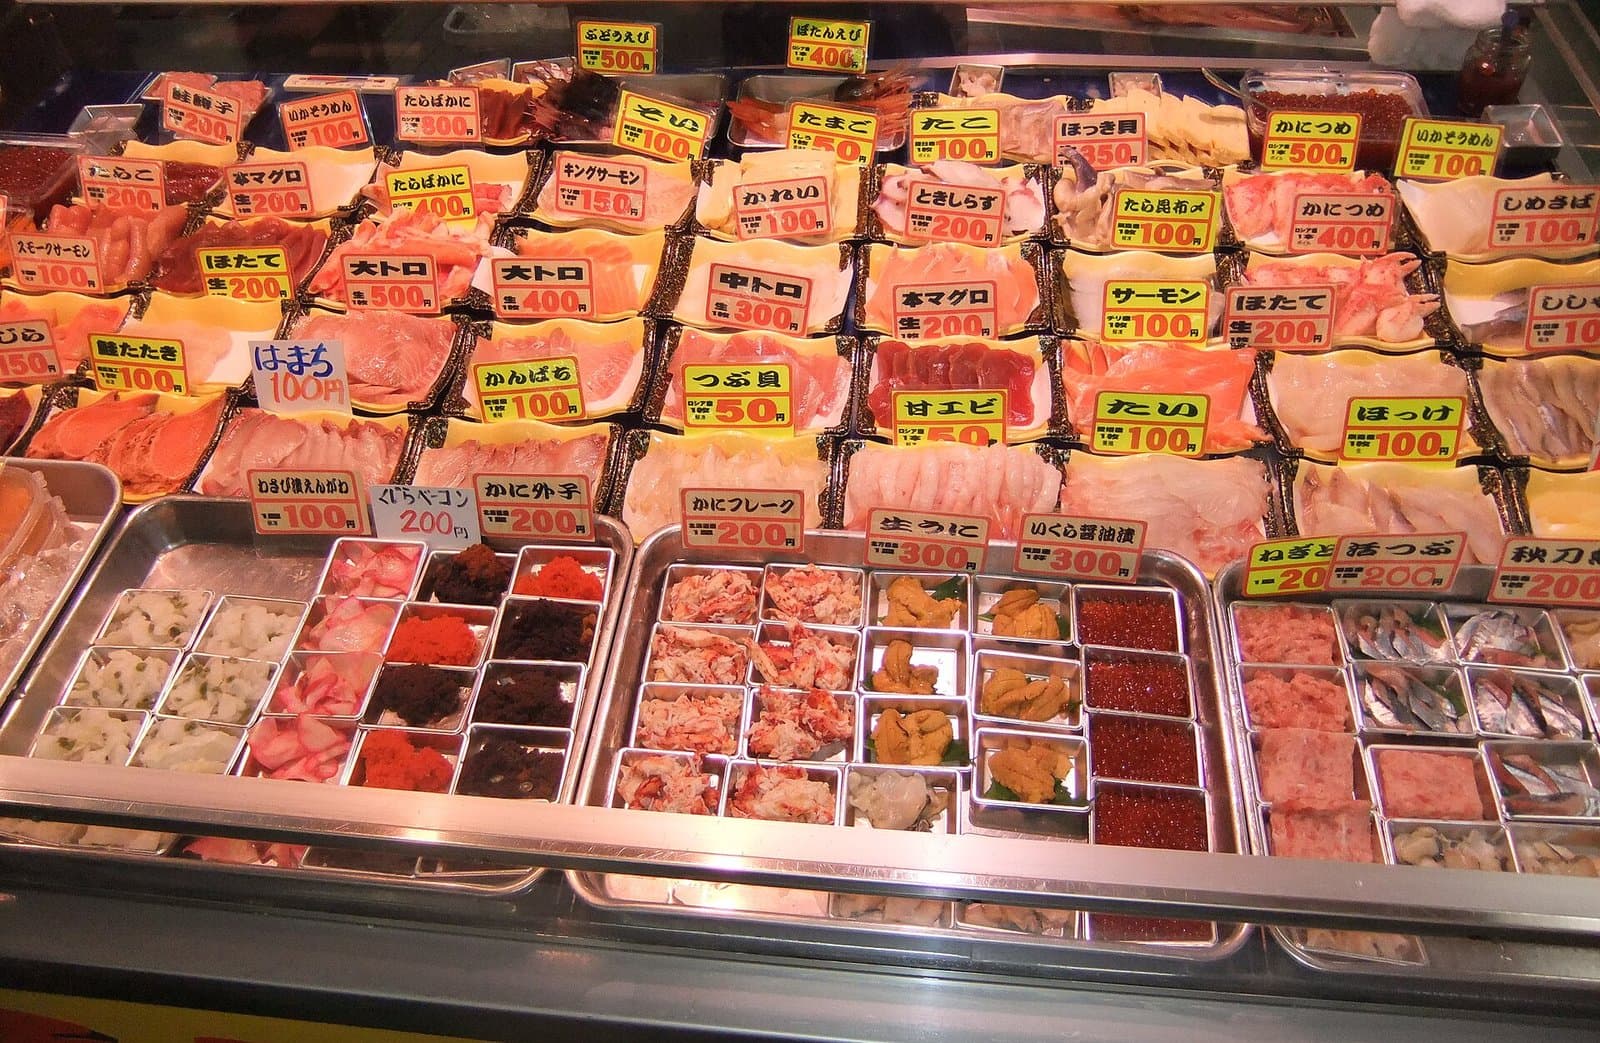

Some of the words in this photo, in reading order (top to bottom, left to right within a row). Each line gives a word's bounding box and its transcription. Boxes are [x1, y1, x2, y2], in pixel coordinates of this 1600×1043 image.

[585, 29, 650, 43] ぶどうえび
[797, 24, 862, 41] ぼたんえび
[601, 50, 649, 70] 500円
[810, 47, 858, 68] 400円
[288, 100, 352, 122] いかそうめん
[404, 94, 471, 108] たらばかに
[184, 113, 232, 143] 200円
[421, 115, 473, 135] 800円
[633, 104, 699, 132] そい
[799, 111, 872, 133] たまご
[921, 117, 991, 131] たこ
[1061, 120, 1137, 136] ほっき貝
[1276, 119, 1351, 135] かにつめ
[311, 121, 360, 145] 100円
[1416, 128, 1493, 147] いかそうめん
[643, 130, 694, 160] 100円
[813, 135, 866, 163] 50円
[936, 138, 993, 159] 100円
[1080, 144, 1137, 165] 350円
[1289, 143, 1347, 165] 500円
[233, 168, 301, 187] 本マグロ
[393, 174, 465, 192] たらばかに
[564, 163, 639, 185] キングサーモン
[107, 187, 159, 210] 200円
[234, 193, 251, 206] 生
[254, 192, 308, 213] 200円
[415, 196, 470, 217] 400円
[580, 189, 638, 216] 150円
[743, 186, 819, 206] かれい
[916, 189, 998, 210] ときしらず
[1504, 193, 1595, 211] しめさば
[1303, 202, 1384, 217] かにつめ
[766, 209, 823, 232] 100円
[932, 215, 992, 242] 200円
[1525, 220, 1586, 242] 100円
[1140, 223, 1200, 245] 100円
[1317, 227, 1380, 249] 400円
[18, 240, 90, 258] スモークサーモン
[206, 254, 280, 269] ほたて
[350, 260, 426, 276] 大トロ
[38, 265, 96, 288] 100円
[501, 265, 583, 281] 大トロ
[207, 278, 227, 290] 生
[229, 277, 287, 298] 200円
[720, 272, 802, 299] 中トロ
[352, 291, 365, 299] 生
[371, 285, 431, 307] 500円
[503, 296, 516, 304] 生
[522, 290, 587, 312] 400円
[902, 289, 988, 308] 本マグロ
[1112, 288, 1200, 304] サーモン
[1235, 294, 1327, 311] ほたて
[714, 302, 728, 311] 生
[734, 300, 798, 331] 300円
[899, 317, 920, 330] 生
[923, 315, 990, 338] 200円
[1131, 314, 1199, 337] 100円
[1229, 320, 1252, 334] 生
[1255, 320, 1322, 344] 200円
[97, 339, 177, 362] 鮭たたき
[254, 343, 333, 377] はまち
[0, 352, 56, 375] 150円
[119, 367, 182, 393] 100円
[485, 366, 570, 387] かんぱち
[692, 370, 782, 389] つぶ貝
[270, 373, 344, 403] 100円
[512, 391, 577, 418] 100円
[715, 398, 785, 423] 50円
[904, 398, 998, 416] 甘エビ
[1106, 399, 1198, 417] たい
[1356, 405, 1454, 421] ほっけ
[927, 425, 998, 447] 50円
[1128, 426, 1196, 452] 100円
[1375, 431, 1449, 456] 100円
[258, 476, 349, 494] わさび漬えんがわ
[484, 481, 582, 500] かに外子
[378, 487, 468, 508] くじらベーコン
[692, 496, 795, 514] かにフレーク
[283, 505, 356, 529] 100円
[400, 509, 468, 539] 200円
[510, 509, 585, 534] 200円
[879, 516, 979, 538] 生うに
[717, 522, 795, 547] 200円
[1030, 521, 1135, 544] いくら醤油漬
[898, 542, 976, 570] 300円
[1346, 540, 1453, 557] 活つぶ
[1050, 548, 1129, 577] 300円
[1362, 566, 1443, 587] 200円
[1527, 574, 1600, 600] 200
